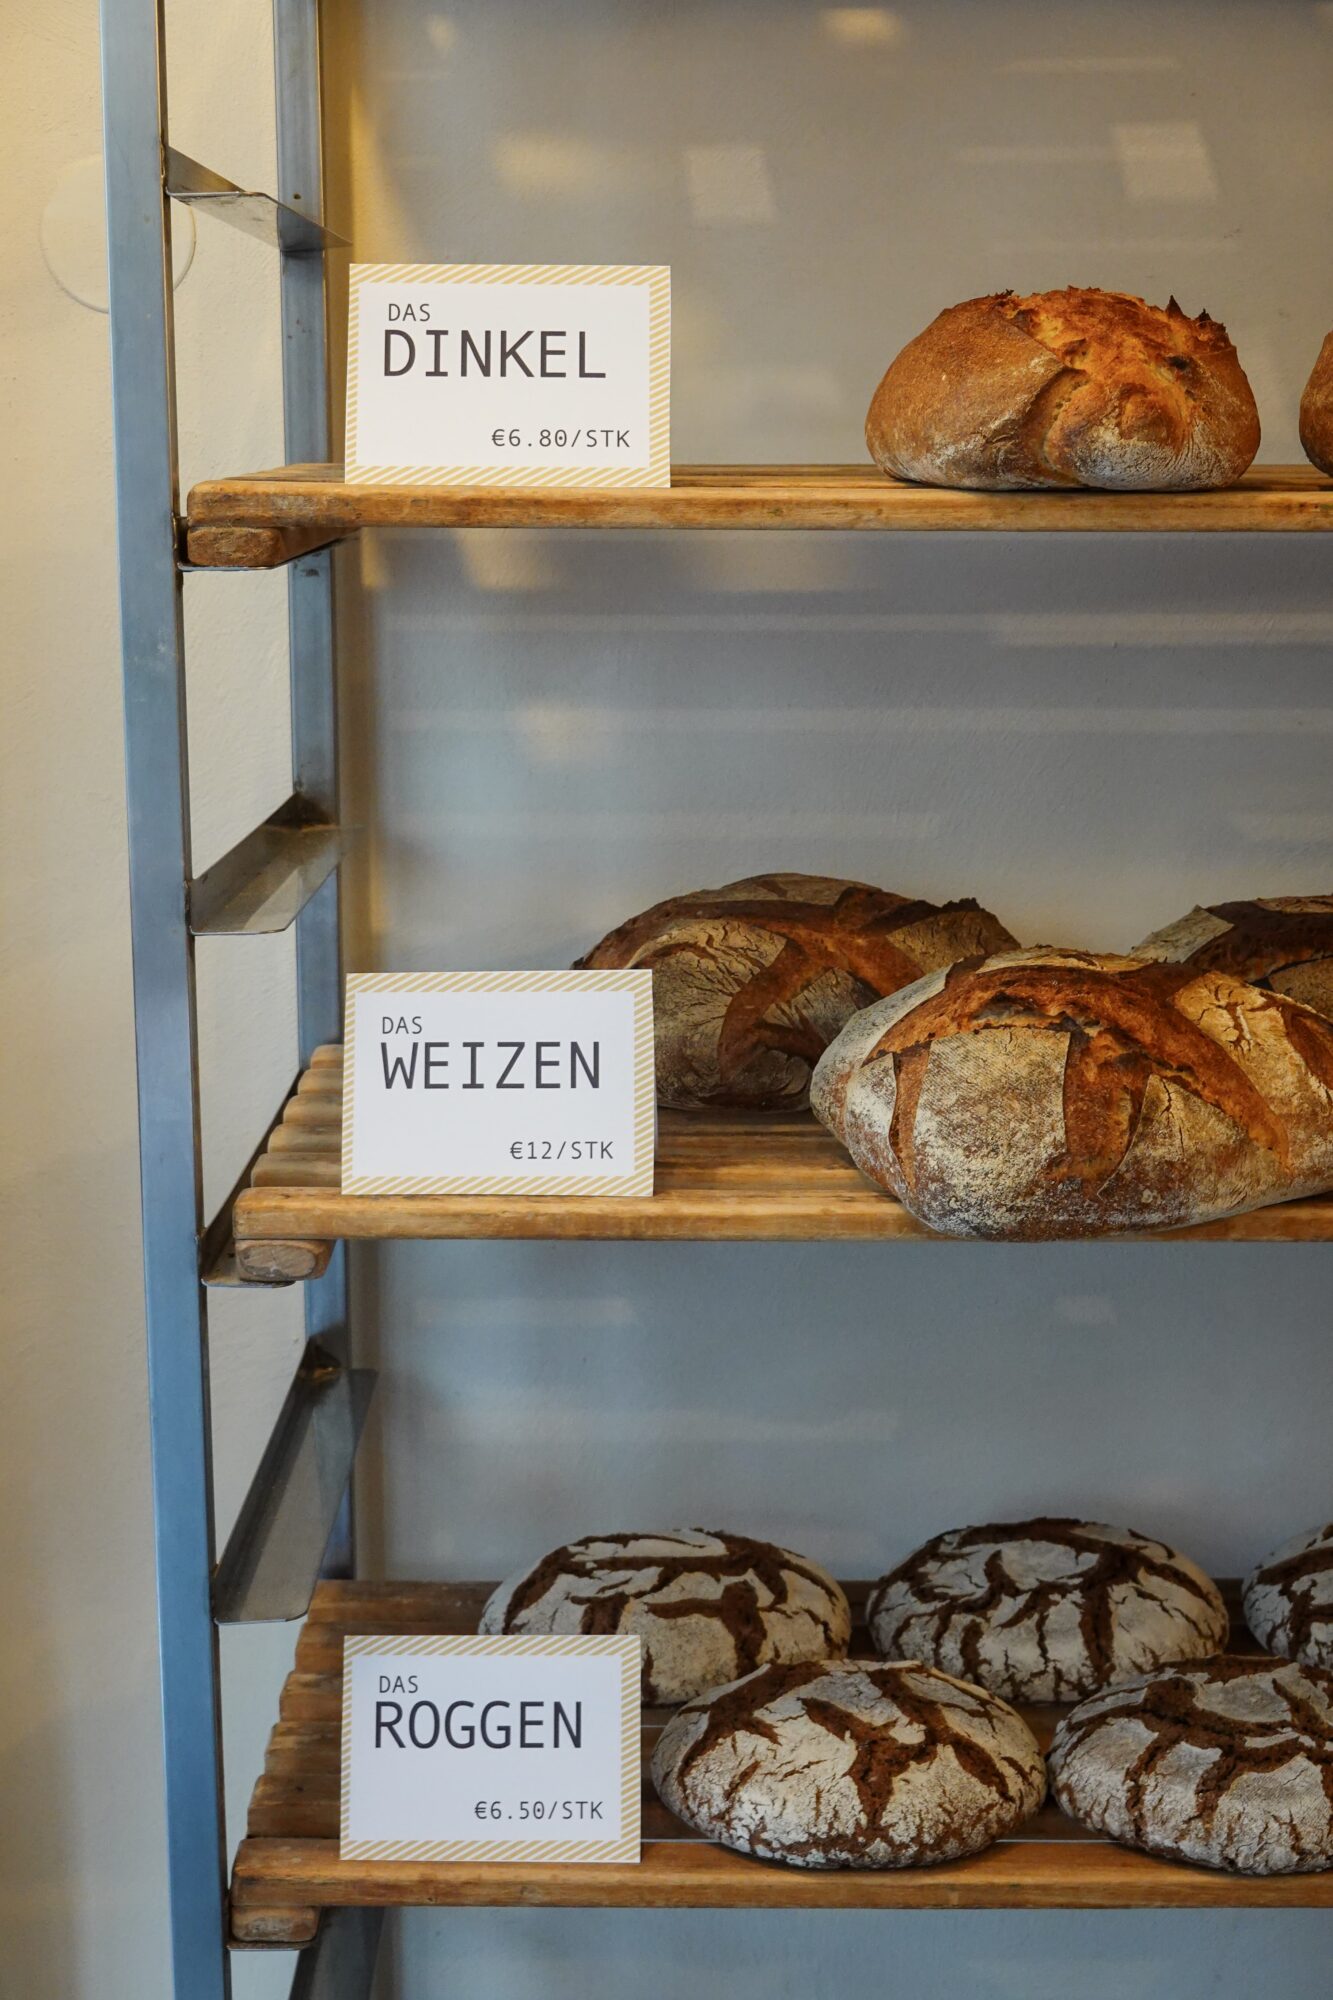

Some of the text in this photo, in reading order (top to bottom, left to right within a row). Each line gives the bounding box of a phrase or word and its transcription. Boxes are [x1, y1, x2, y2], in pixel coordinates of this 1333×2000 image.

[388, 303, 431, 322] DAS
[384, 329, 606, 379] DINKEL
[491, 428, 630, 448] €6.80/STK
[382, 1016, 423, 1035] DAS
[381, 1041, 600, 1090] WEIZEN
[509, 1141, 613, 1160] €12/STK
[379, 1675, 419, 1694] DAS
[375, 1700, 582, 1750] ROGGEN
[474, 1800, 603, 1820] €6.50/STK
